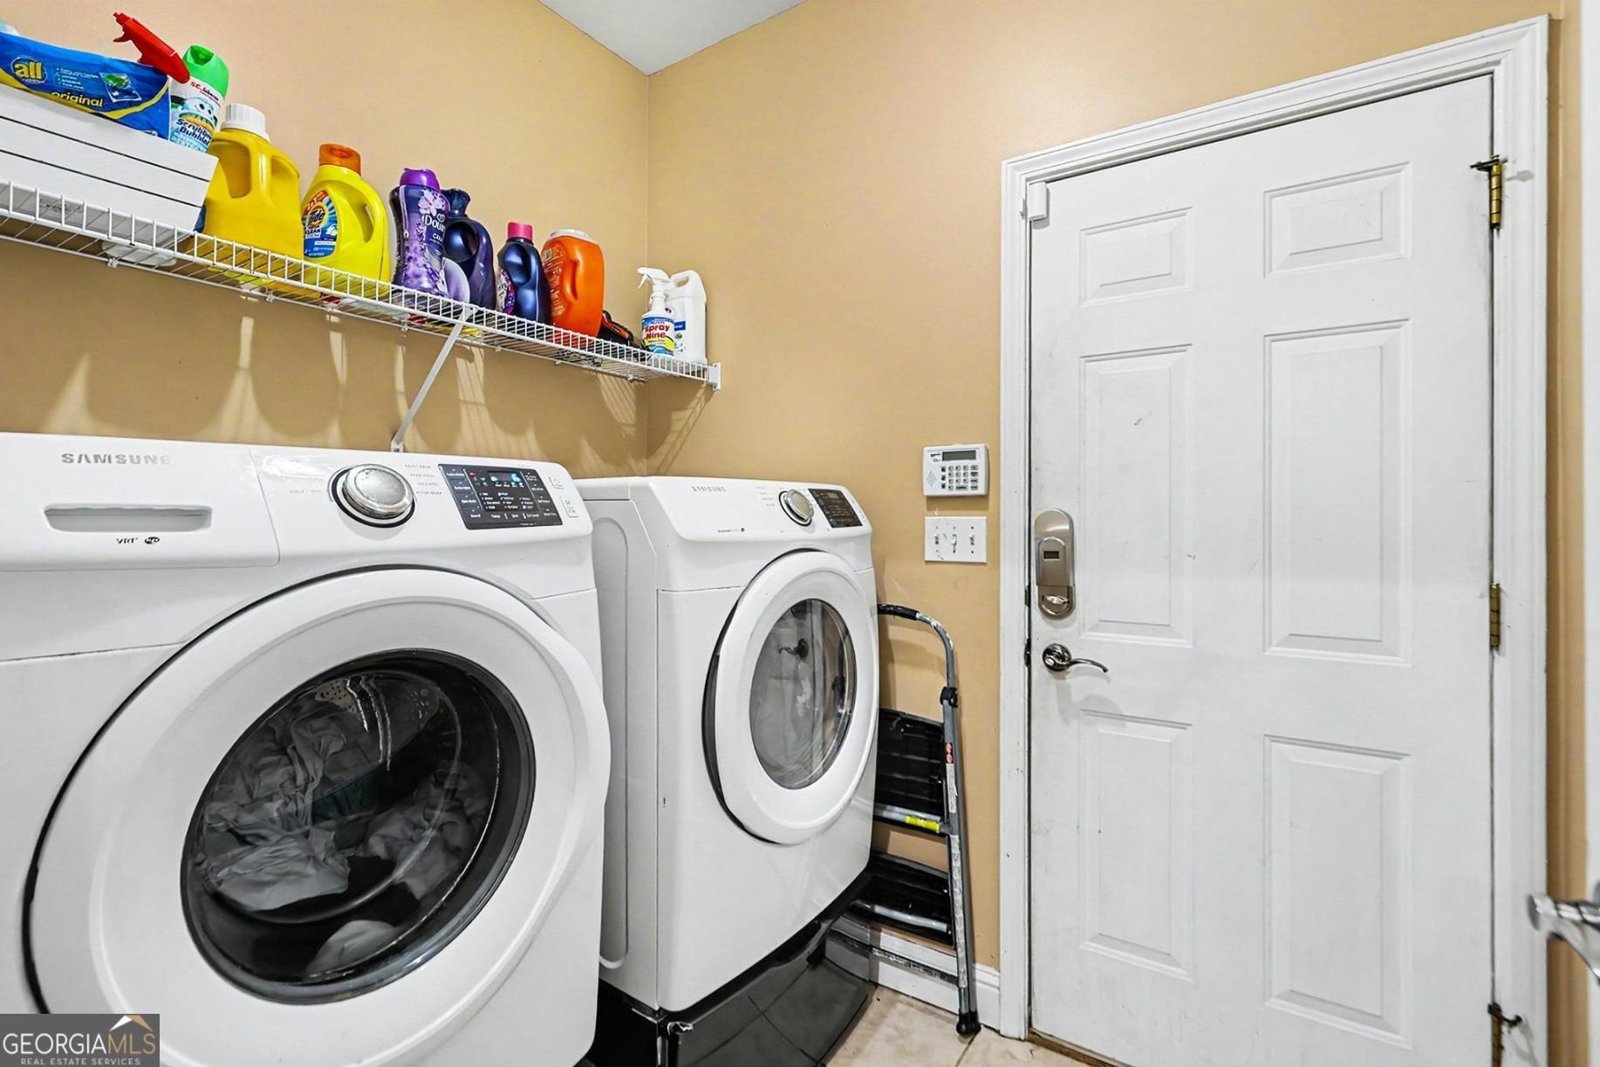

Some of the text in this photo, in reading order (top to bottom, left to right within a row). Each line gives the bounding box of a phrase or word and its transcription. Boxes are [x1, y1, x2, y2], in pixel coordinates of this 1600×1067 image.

[14, 61, 42, 80] all
[51, 91, 104, 107] original
[646, 332, 666, 340] Nine
[61, 453, 171, 465] SAMSUNG
